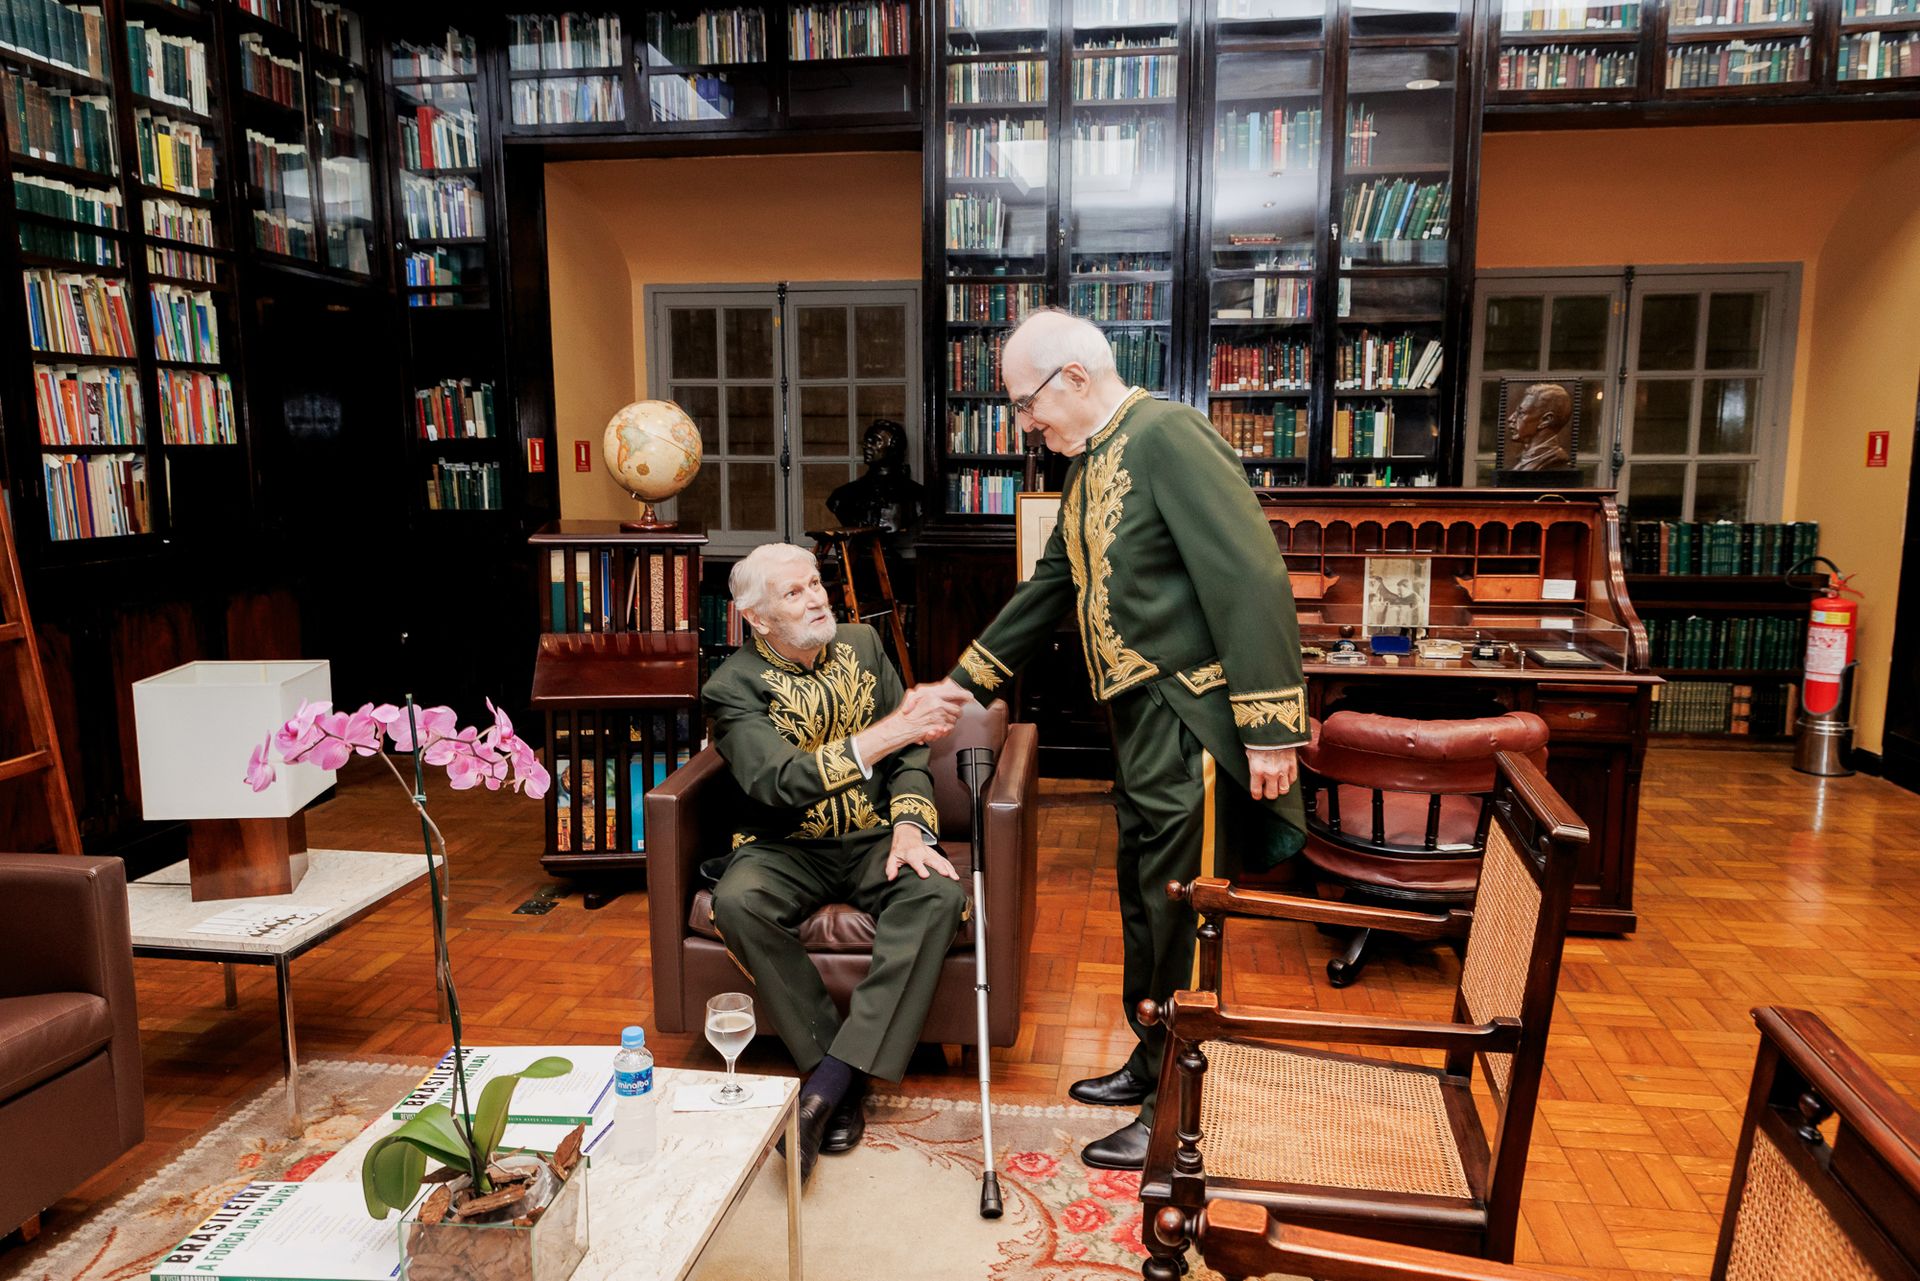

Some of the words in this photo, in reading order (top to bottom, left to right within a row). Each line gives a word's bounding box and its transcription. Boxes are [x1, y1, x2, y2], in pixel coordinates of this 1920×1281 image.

[617, 1079, 649, 1089] minalba
[250, 1183, 303, 1217] PALAVRA
[164, 1183, 275, 1264] BRASILEIRA
[237, 1217, 264, 1230] DA
[203, 1231, 251, 1261] FORÇA
[194, 1263, 219, 1272] A
